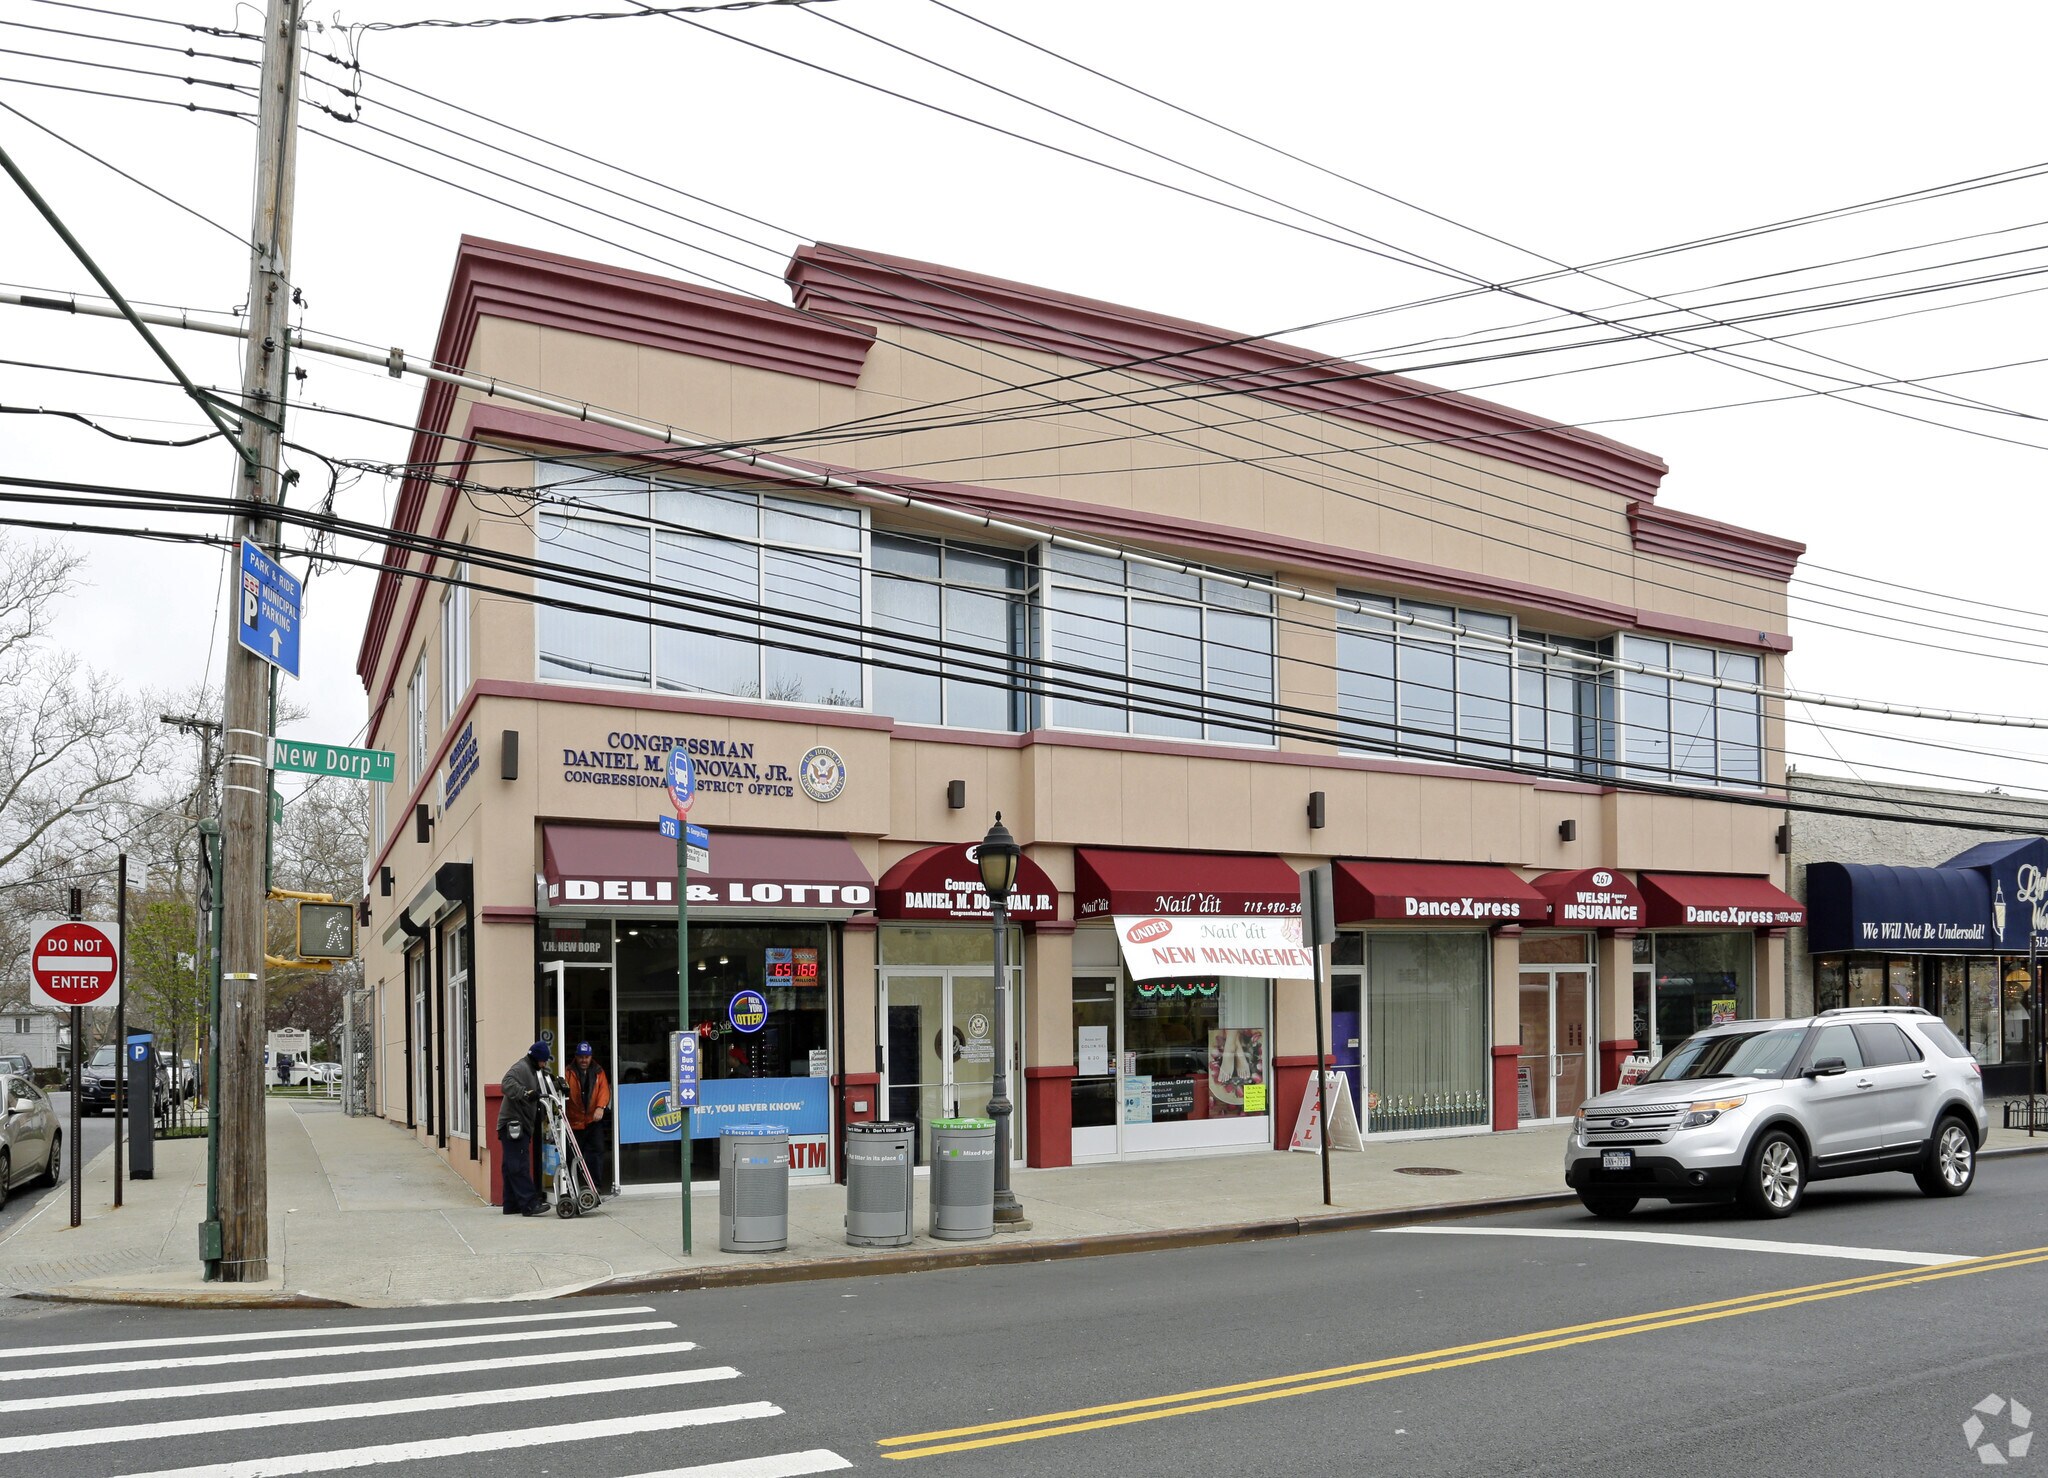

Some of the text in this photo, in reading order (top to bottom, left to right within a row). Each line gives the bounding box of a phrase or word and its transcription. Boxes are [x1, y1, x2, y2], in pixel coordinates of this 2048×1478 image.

[249, 552, 295, 596] PARK & RIDE
[243, 590, 258, 621] P
[262, 584, 298, 620] MUNICIPAL
[262, 602, 291, 633] PARKING
[275, 743, 390, 778] New Dorp Ln
[563, 749, 638, 770] DANIEL
[644, 755, 663, 772] M.
[765, 764, 793, 782] JR.
[564, 771, 668, 789] CONGRESSIONA
[748, 783, 794, 797] OFFICE
[1596, 874, 1609, 884] 267
[564, 879, 672, 901] DELI
[686, 885, 719, 901] &
[729, 882, 870, 904] LOTTO
[1576, 892, 1611, 904] WELSH
[905, 892, 1053, 912] DANIEL M. DOVAN, JR.
[1154, 894, 1195, 912] Nail
[1405, 897, 1520, 919] DanceXpress
[1564, 904, 1638, 920] INSURANCE
[1687, 906, 1773, 925] DanceXpress
[1130, 920, 1170, 941] UNDER
[1200, 923, 1239, 939] Nail
[1862, 923, 1985, 939] We Will Not Be Undersold!
[47, 938, 102, 952] DO NOT
[542, 942, 600, 953] Y.H. NEW DORP
[1152, 947, 1313, 966] NEW MANAGEMEN
[775, 963, 817, 977] 65 168
[51, 975, 99, 989] ENTER
[734, 1013, 764, 1026] LOTTERY
[135, 1046, 144, 1059] P
[693, 1105, 714, 1115] HEY,
[715, 1104, 735, 1112] YOU
[738, 1103, 768, 1112] NEVER
